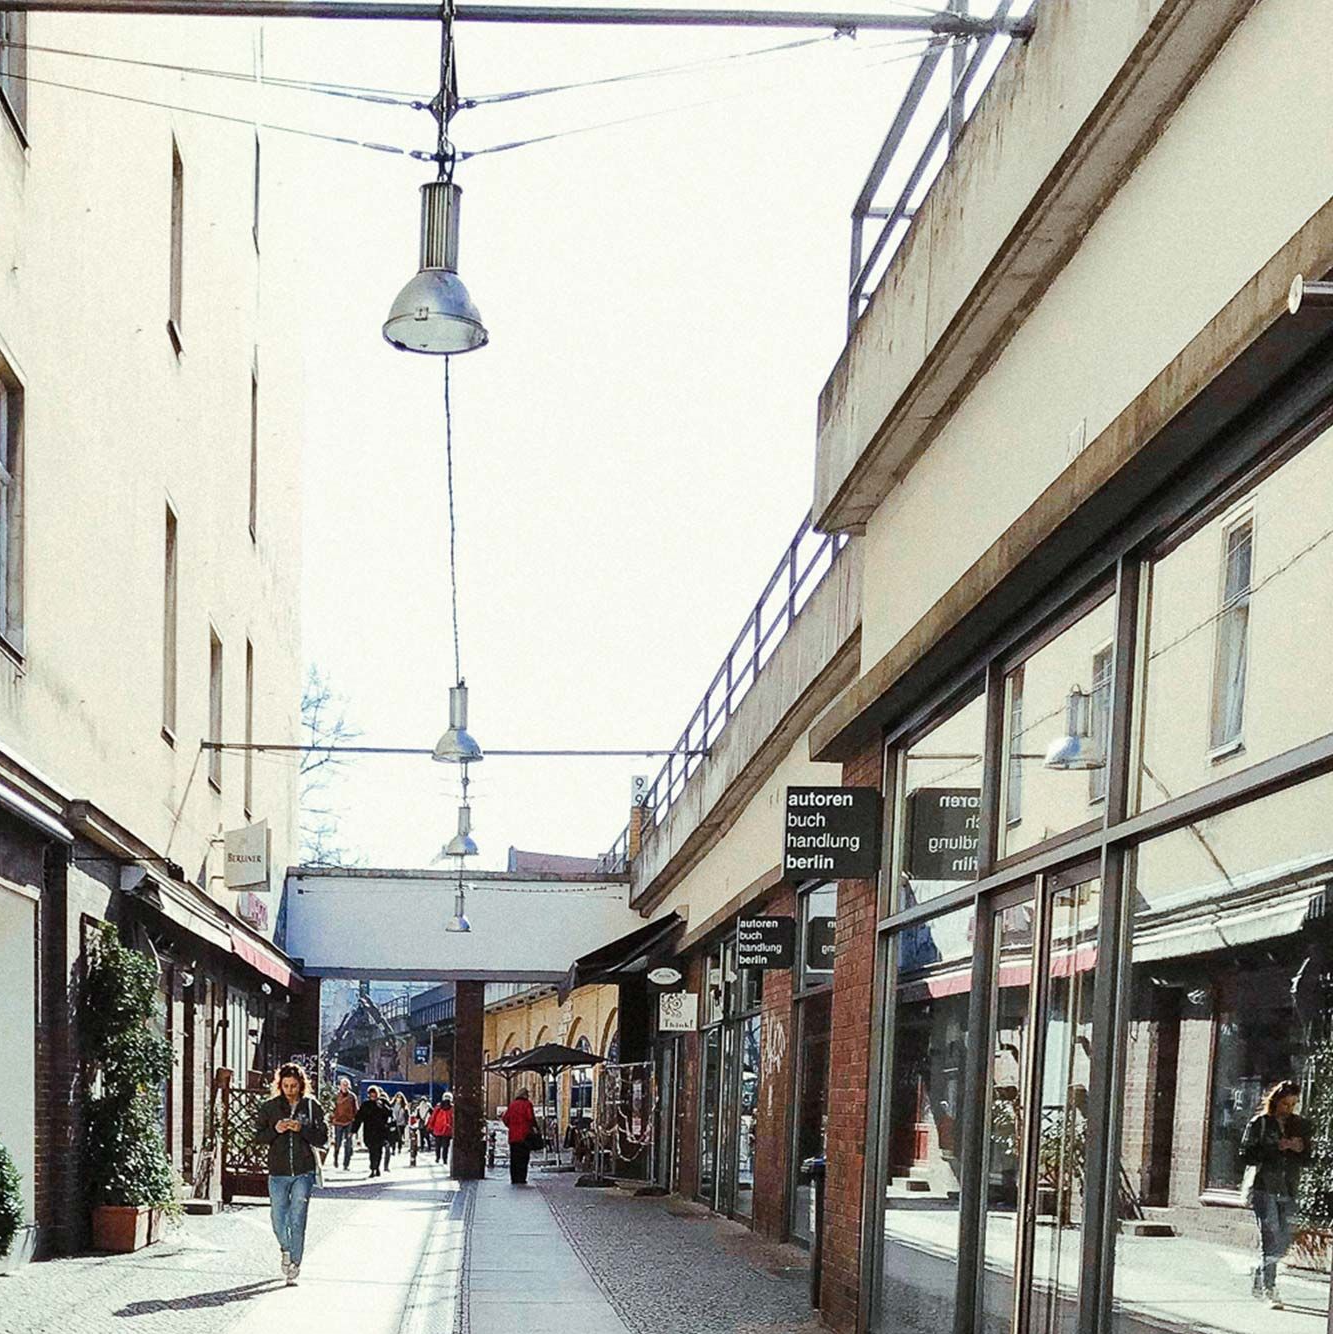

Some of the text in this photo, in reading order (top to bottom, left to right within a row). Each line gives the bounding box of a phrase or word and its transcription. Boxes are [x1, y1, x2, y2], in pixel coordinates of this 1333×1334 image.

[787, 791, 854, 808] autoren
[787, 812, 826, 829] buch
[786, 833, 861, 853] handlung
[785, 854, 835, 870] berlin
[739, 919, 779, 928] autoren
[739, 931, 763, 940] buch
[739, 943, 783, 955] handlung
[738, 955, 768, 964] berlin
